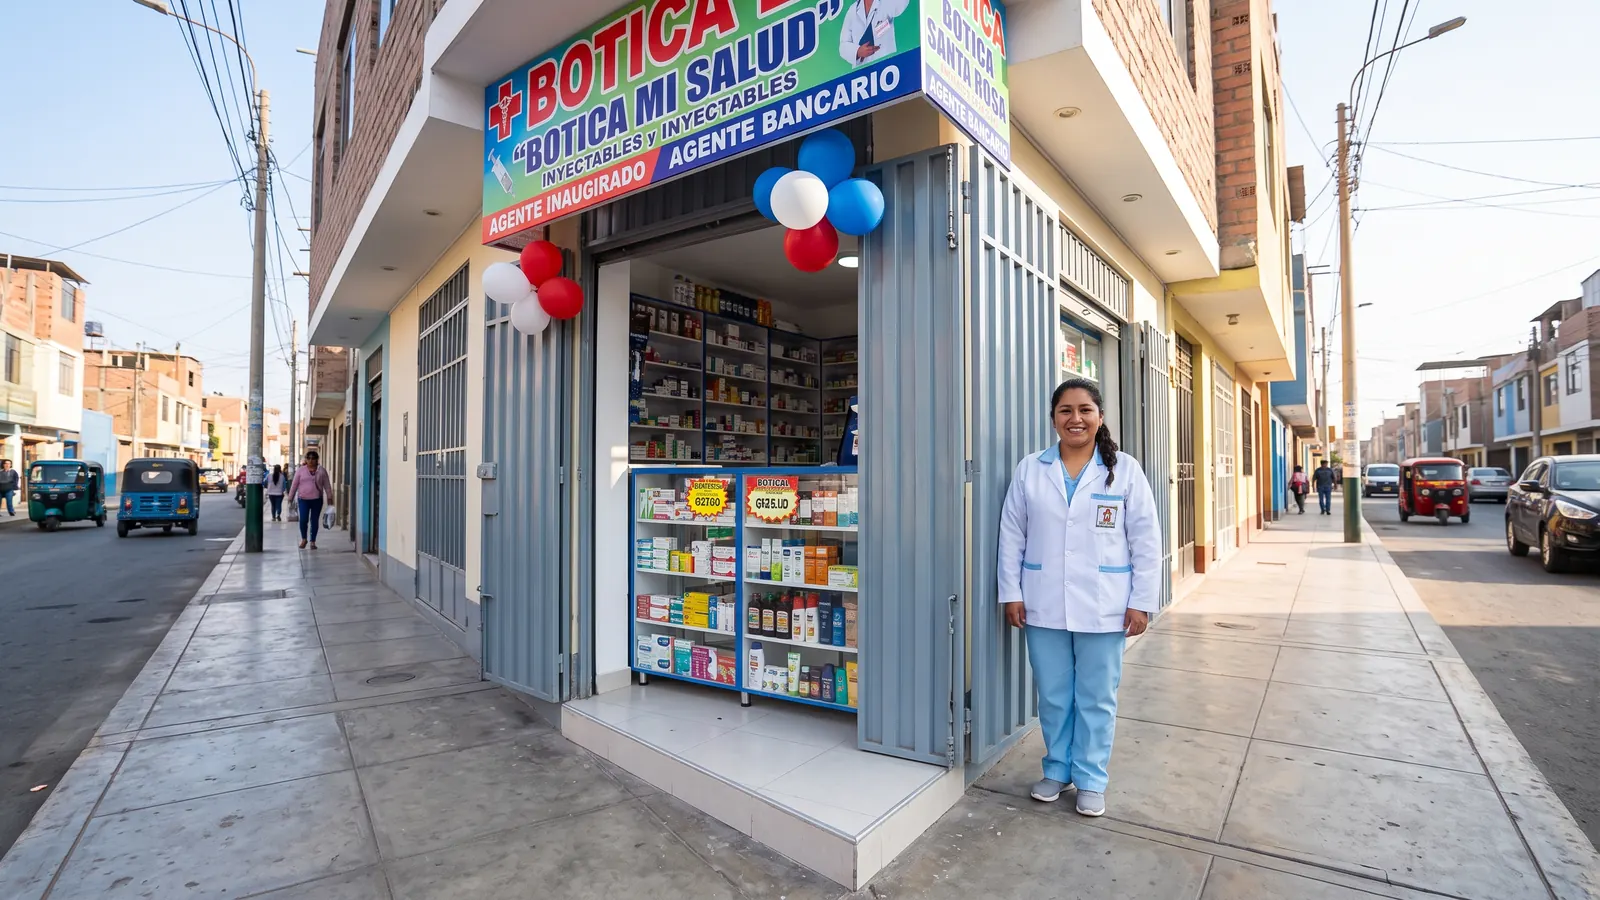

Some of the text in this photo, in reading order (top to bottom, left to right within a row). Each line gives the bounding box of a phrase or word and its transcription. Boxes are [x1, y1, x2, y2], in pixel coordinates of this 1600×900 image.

[527, 0, 738, 129] BOTICA
[927, 17, 972, 89] SANTA
[974, 67, 1007, 124] ROSA
[942, 0, 995, 79] BOTICA
[542, 71, 797, 188] INYECTABLES y INYECTABLES
[634, 71, 677, 128] MI
[669, 117, 755, 170] AGENTE
[762, 64, 900, 136] BANCARIO
[929, 74, 967, 121] AGENTE
[967, 109, 1008, 161] BANCARIO
[489, 160, 646, 237] AGENTE INAUGIRADO
